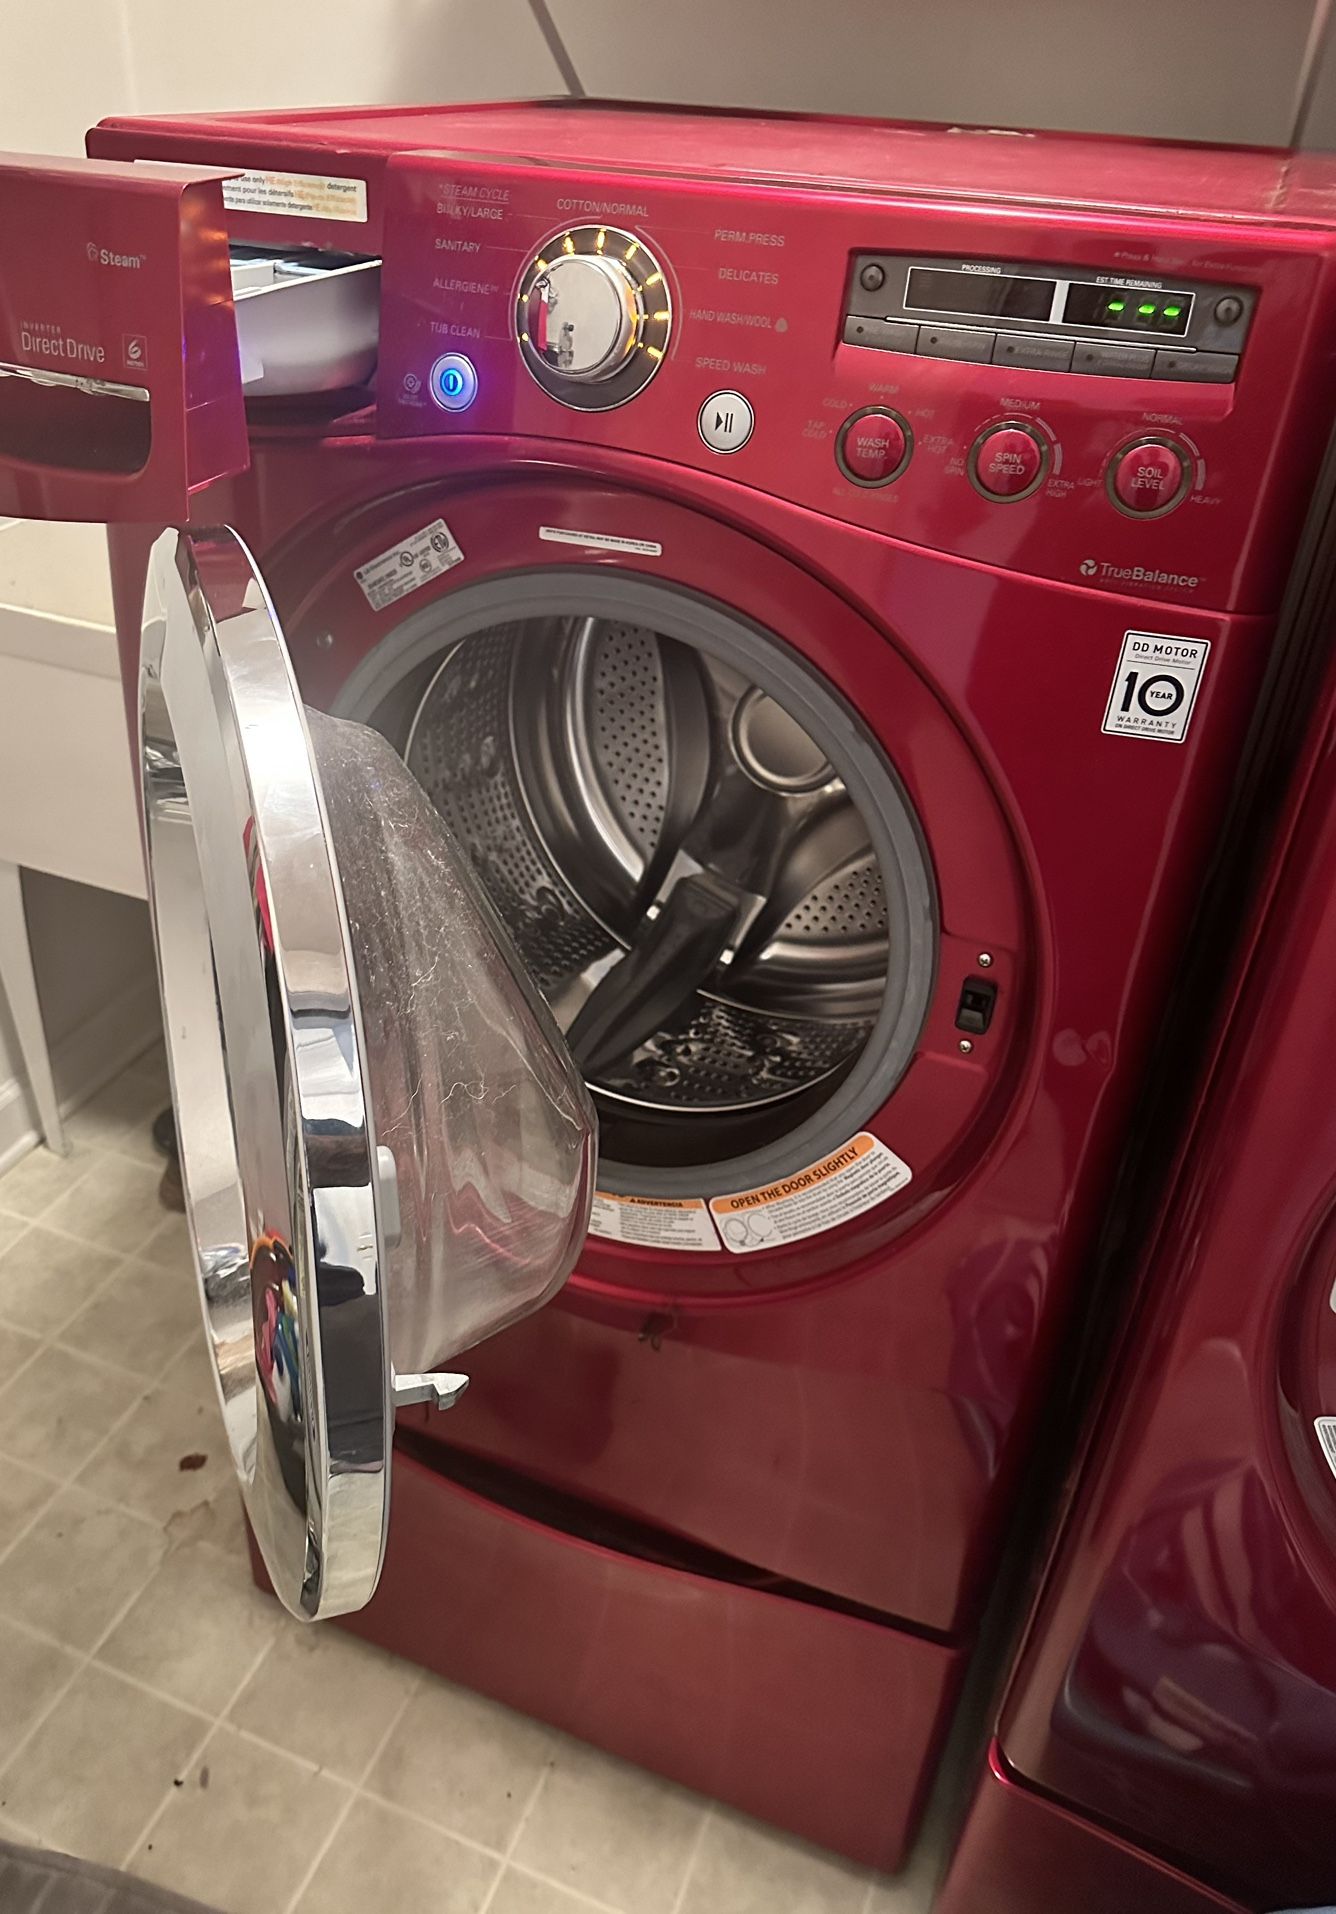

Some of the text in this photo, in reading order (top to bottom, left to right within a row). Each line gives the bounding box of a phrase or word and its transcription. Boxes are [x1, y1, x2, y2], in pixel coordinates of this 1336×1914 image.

[252, 177, 265, 185] only
[327, 182, 358, 193] detergent
[479, 187, 510, 201] CYCLE
[436, 203, 504, 220] BULKY/LARGE
[556, 198, 650, 218] COTTON/NORMAL
[434, 238, 481, 253] SANITARY
[961, 263, 1002, 274] PROCESSING
[718, 267, 780, 286] DELICATES
[1125, 279, 1163, 289] REMAINING
[689, 308, 773, 330] HAND WASH/WOOL
[430, 321, 480, 339] TUB CLEAN
[695, 356, 768, 376] SPEED WASH
[868, 383, 900, 395] WARM
[1000, 397, 1041, 411] MEDIUM
[1142, 412, 1184, 426] NORMAL
[856, 437, 890, 449] WASH
[993, 452, 1023, 464] SPIN
[988, 462, 1026, 476] SPEED
[1137, 466, 1165, 479] SOIL
[1047, 479, 1076, 490] EXTRA
[1130, 477, 1166, 490] LEVEL
[1132, 641, 1198, 659] DD MOTOR
[1120, 671, 1185, 717] 10
[1150, 691, 1173, 701] YEAR
[1117, 715, 1177, 729] WARRANTY
[730, 1194, 761, 1210] OPEN
[761, 1187, 783, 1203] THE
[783, 1174, 814, 1194] DOOR
[814, 1146, 859, 1180] SLIGHTLY
